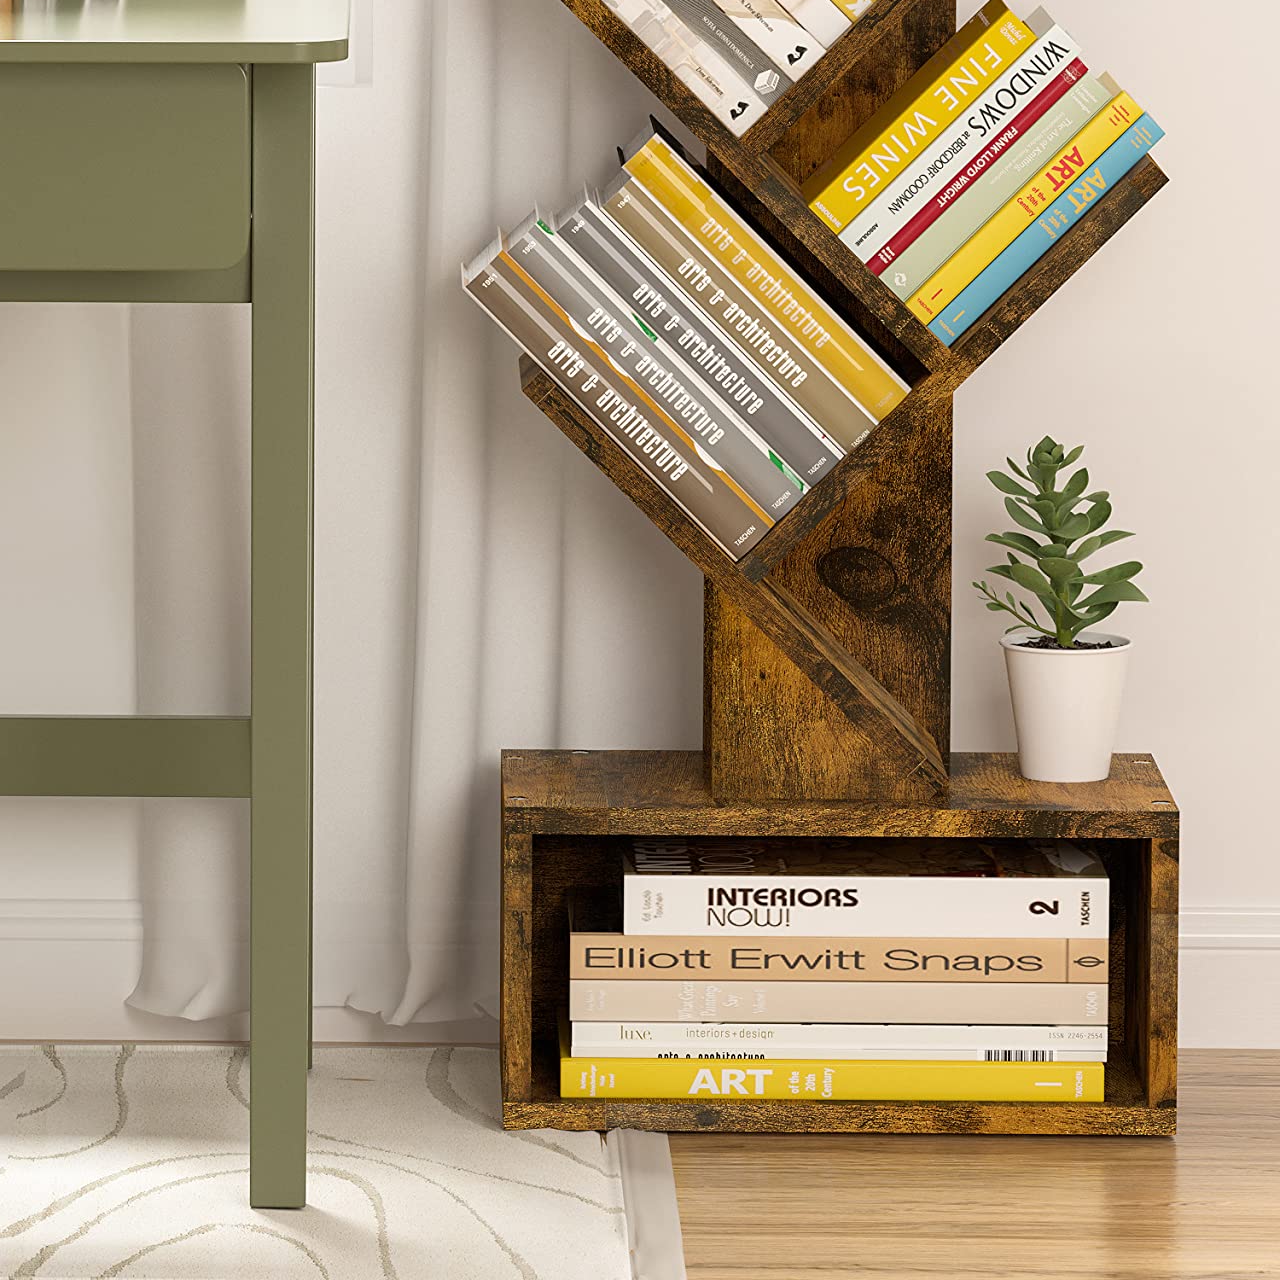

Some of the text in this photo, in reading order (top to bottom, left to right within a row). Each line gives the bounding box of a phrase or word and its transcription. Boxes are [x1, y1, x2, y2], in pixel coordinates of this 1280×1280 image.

[932, 41, 1003, 112] FINE
[965, 33, 1070, 139] WINDOWS
[960, 130, 972, 141] at
[1037, 137, 1050, 150] of
[1045, 127, 1060, 143] Art
[839, 105, 938, 203] WINES
[924, 136, 966, 178] BERGDORF
[934, 125, 1018, 208] FRANK LLOYD WRIGHT
[1040, 144, 1089, 193] ART
[886, 172, 930, 215] GOODMAN
[1025, 193, 1039, 207] 20th
[1030, 184, 1048, 202] of the
[1061, 166, 1111, 215] ART
[1014, 196, 1036, 218] Century
[854, 222, 879, 247] ASSOULINE
[698, 214, 836, 349] arts architecture
[676, 254, 715, 293] arts
[720, 298, 812, 389] architecture
[630, 280, 670, 319] arts
[675, 324, 768, 416] architecture
[585, 303, 625, 344] arts
[632, 350, 729, 446] architecture
[545, 336, 588, 379] arts
[593, 383, 694, 483] architecture
[849, 428, 870, 448] TASCHEN
[806, 455, 827, 476] TASCHEN
[770, 489, 791, 510] TASCHEN
[732, 524, 756, 547] TASCHEN
[707, 887, 859, 908] INTERIORS
[1028, 900, 1060, 916] 2
[1080, 891, 1091, 927] TASCHEN
[707, 907, 791, 927] NOW!
[584, 947, 1044, 976] Elliott Erwitt Snaps
[687, 1068, 773, 1096] ART
[788, 1071, 800, 1095] of the
[805, 1073, 816, 1092] 20th
[821, 1067, 835, 1098] Century
